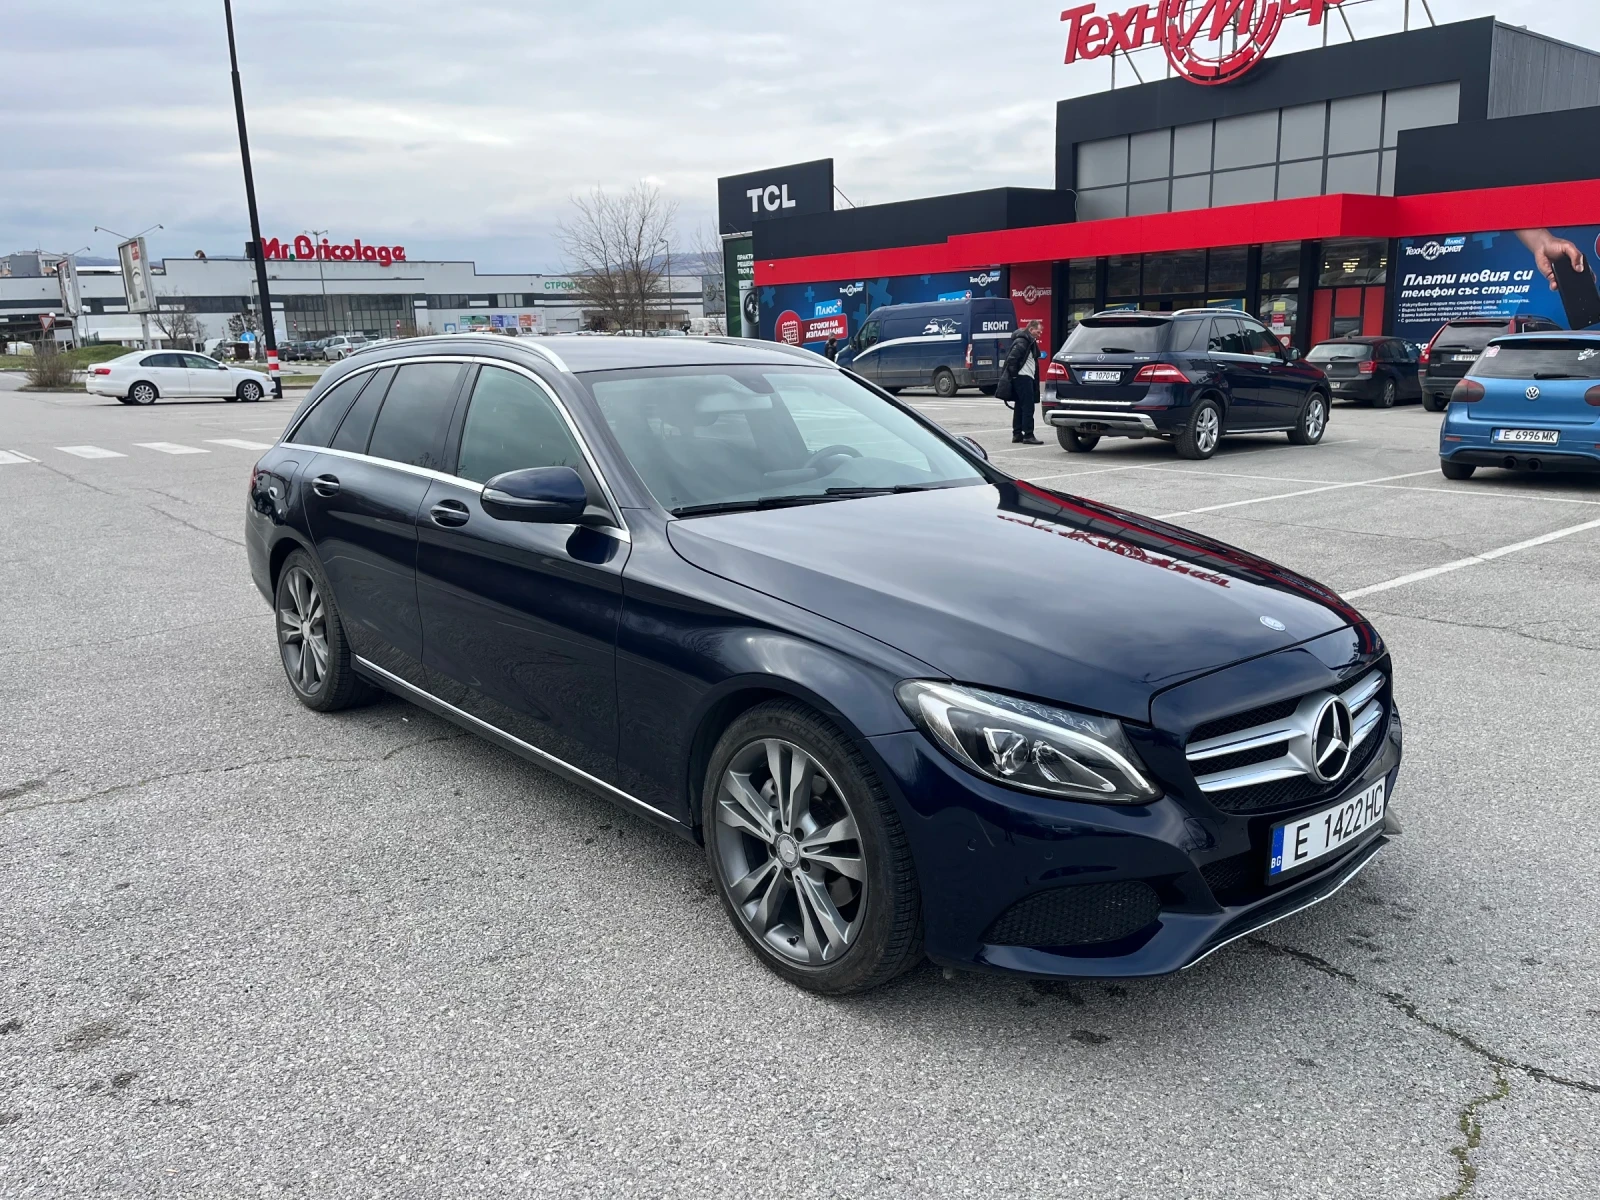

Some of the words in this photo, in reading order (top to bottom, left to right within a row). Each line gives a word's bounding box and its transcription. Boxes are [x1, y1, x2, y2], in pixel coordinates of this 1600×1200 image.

[746, 184, 796, 213] TCL
[294, 235, 406, 267] Bricolage
[1402, 273, 1456, 286] Плати
[1459, 269, 1510, 284] новия
[1513, 270, 1533, 281] си
[1401, 287, 1456, 298] телефон
[1458, 286, 1479, 296] със
[1481, 284, 1530, 295] стария
[816, 305, 838, 316] Плюс
[810, 322, 828, 330] СТОКИ
[830, 320, 838, 328] НА
[982, 321, 1009, 331] ЕКОНТ
[1504, 430, 1510, 439] E
[1294, 822, 1310, 861] E
[1271, 856, 1282, 868] BG
